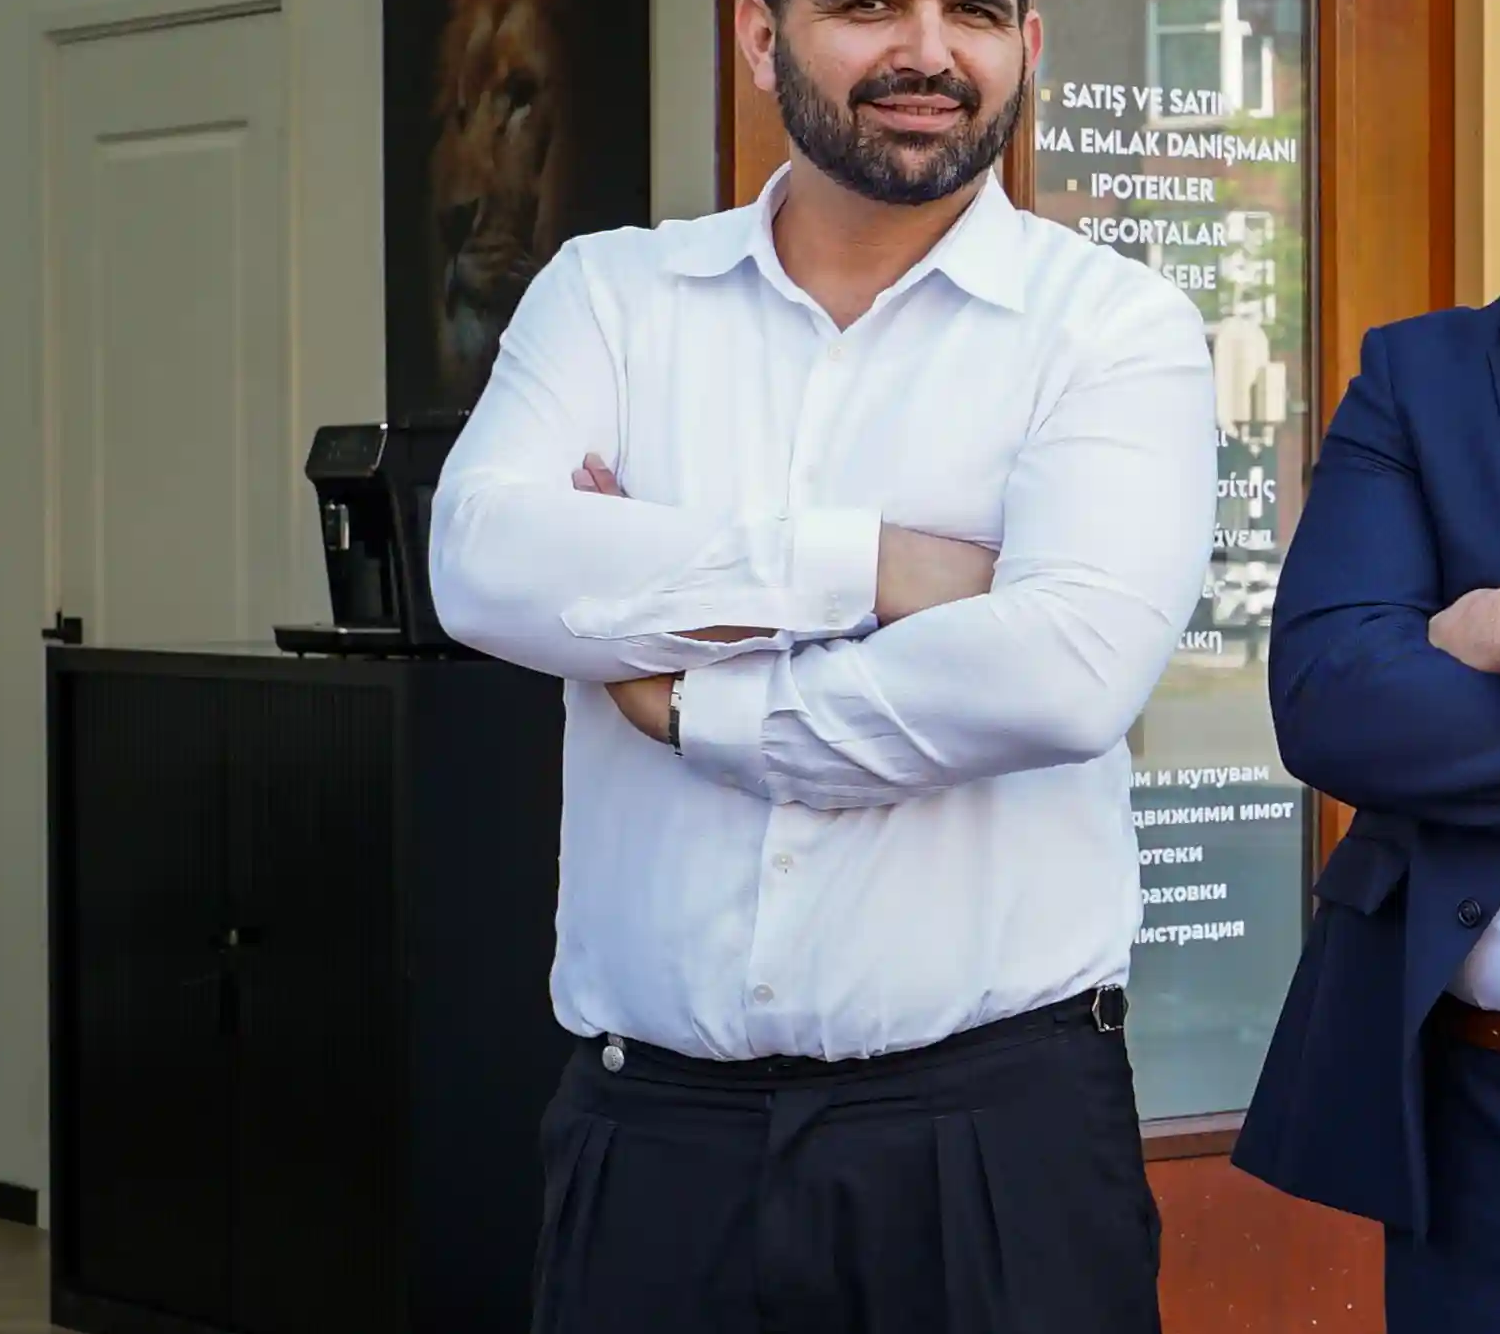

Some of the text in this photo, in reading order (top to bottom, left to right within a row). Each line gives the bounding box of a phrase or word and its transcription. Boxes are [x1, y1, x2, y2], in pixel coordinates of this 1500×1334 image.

[1061, 82, 1127, 117] SATIŞ
[1132, 86, 1164, 113] VE
[1036, 126, 1075, 153] MA
[1080, 128, 1161, 157] EMLAK
[1161, 264, 1217, 290] SEBE
[1177, 766, 1270, 790] купувам
[1132, 804, 1235, 829] движими
[1139, 844, 1204, 866] отеки
